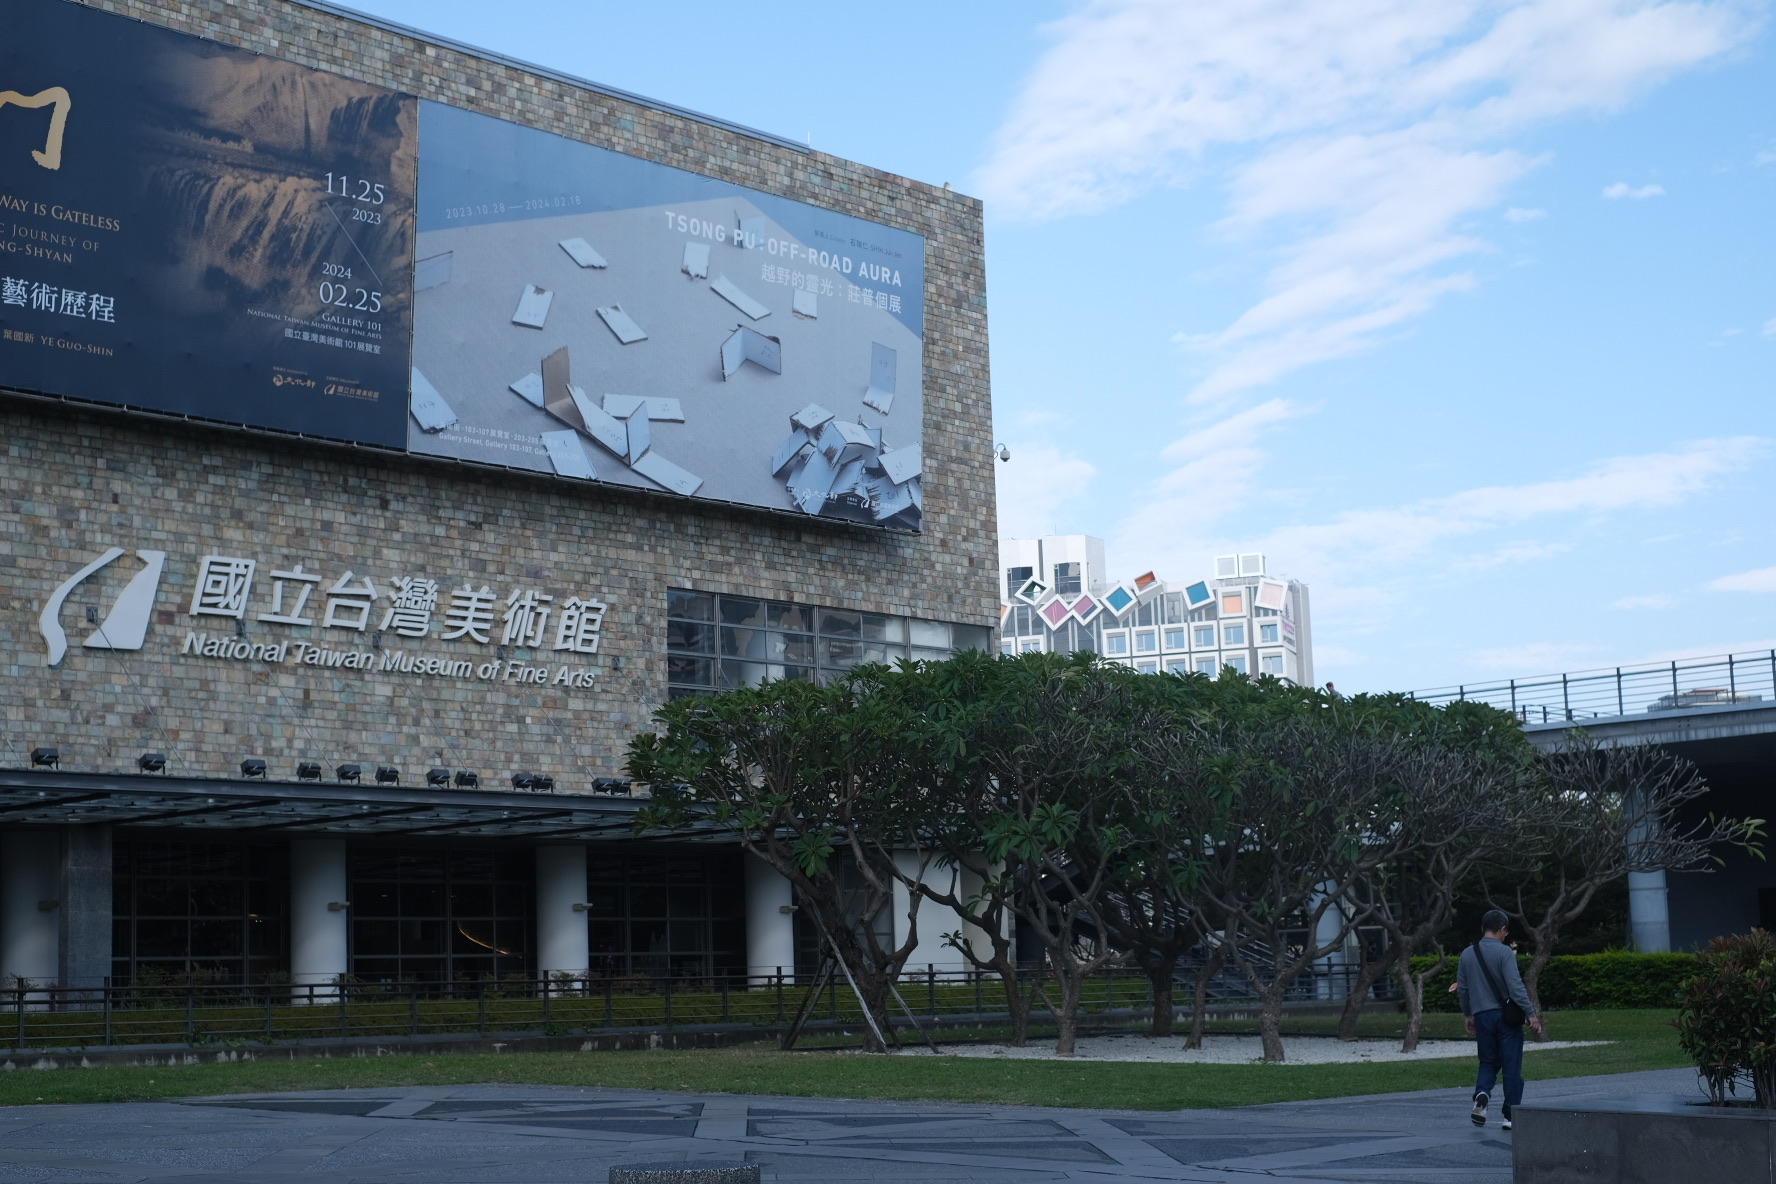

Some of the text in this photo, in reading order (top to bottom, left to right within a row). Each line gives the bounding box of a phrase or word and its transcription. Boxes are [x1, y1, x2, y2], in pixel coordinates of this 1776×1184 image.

[324, 172, 385, 205] 11.25
[352, 207, 381, 225] 2023
[445, 202, 506, 219] 2023.10.28
[525, 195, 582, 210] 2024.02.18
[665, 210, 726, 243] TSONG
[858, 261, 902, 288] AURA
[322, 262, 352, 279] 2024
[1, 276, 116, 323] 藝術歷程
[319, 281, 382, 313] 02.25
[367, 321, 381, 332] 101
[41, 335, 54, 347] YE
[438, 432, 462, 443] Gallery
[463, 436, 484, 446] Street,
[485, 440, 508, 450] Gallery
[188, 554, 608, 654] 國立台灣美術館
[181, 631, 596, 688] National Taiwan Museum of Fine Arts
